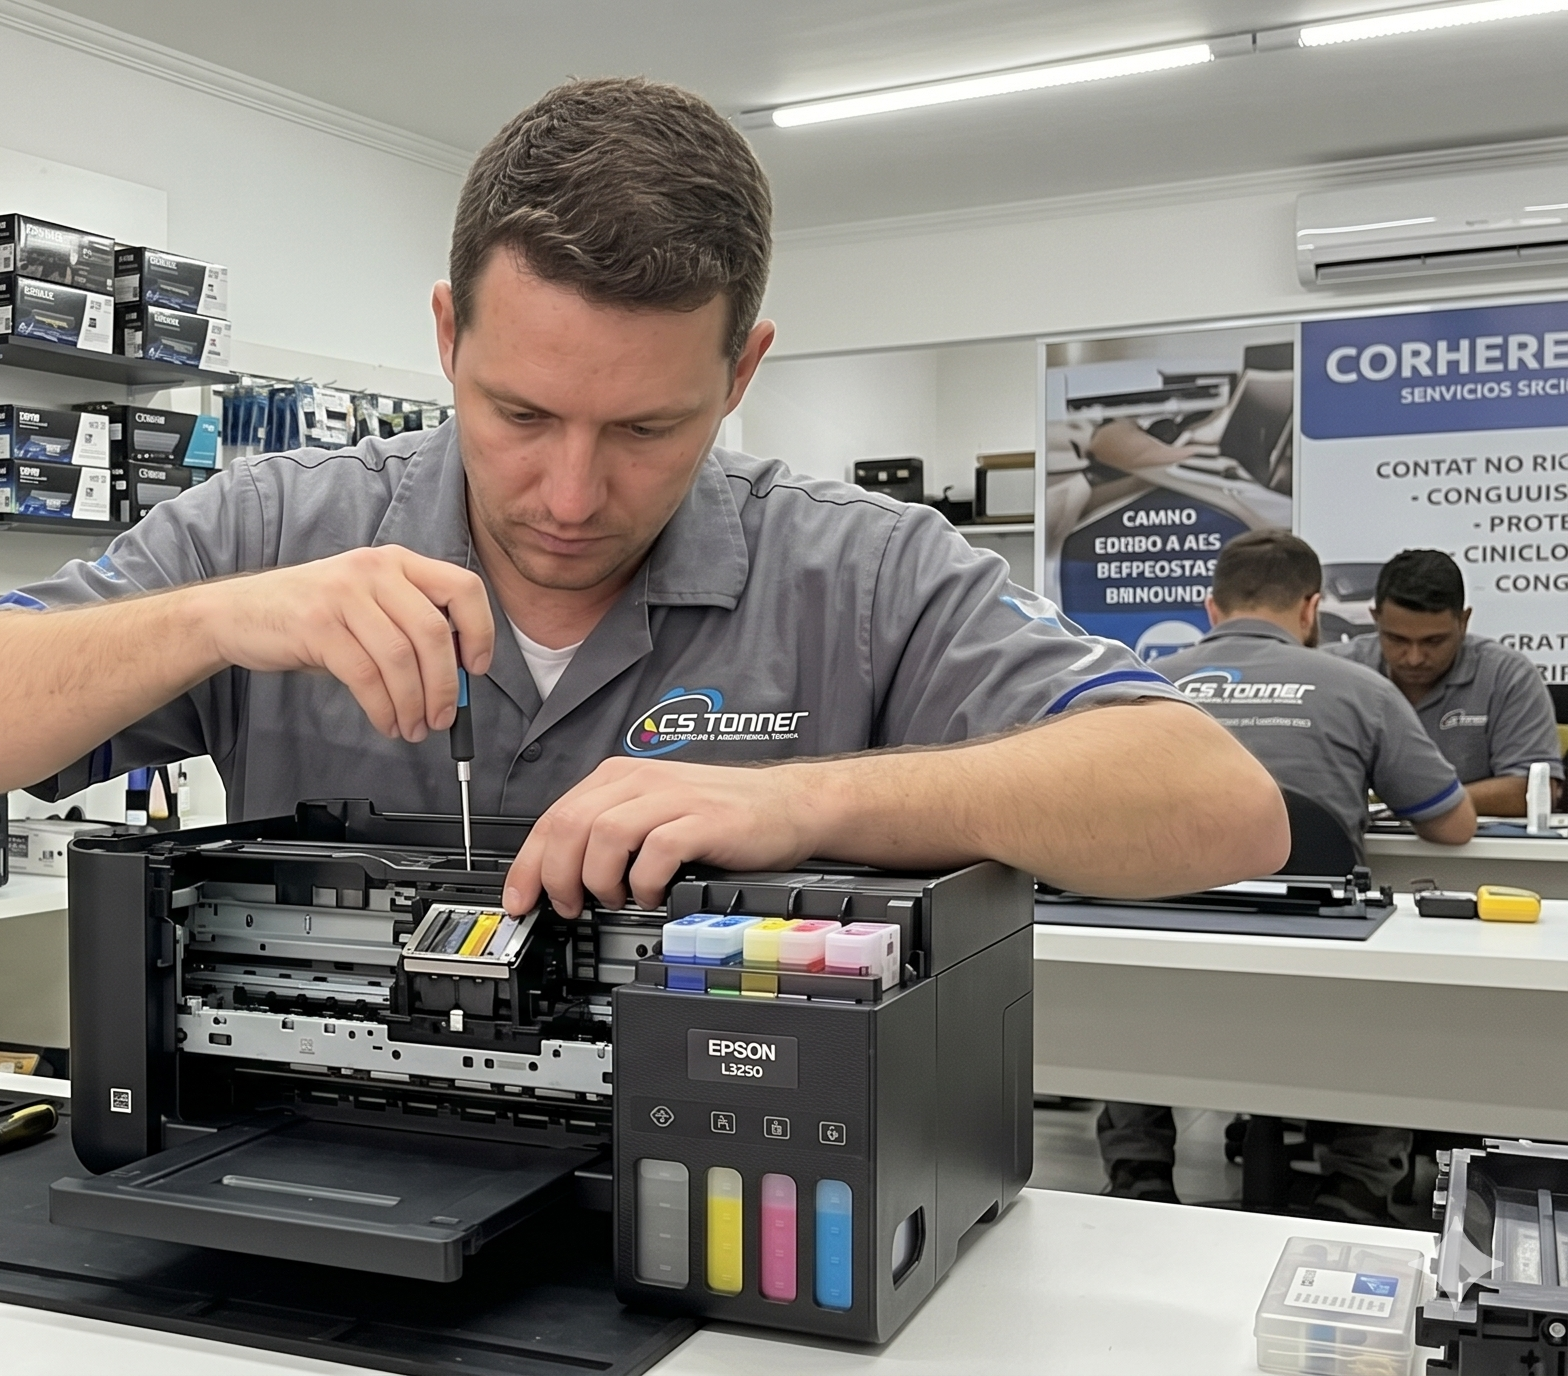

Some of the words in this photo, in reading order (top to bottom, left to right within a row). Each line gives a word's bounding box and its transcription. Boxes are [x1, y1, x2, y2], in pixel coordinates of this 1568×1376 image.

[1326, 331, 1568, 384] CORHERE
[1400, 381, 1512, 404] SENVICIOS
[1517, 377, 1568, 397] SRCI
[1376, 457, 1477, 479] CONTAT
[1485, 455, 1523, 474] NO
[1427, 483, 1568, 506] CONGUUIS
[1122, 508, 1197, 527] CAMNO
[1165, 534, 1180, 551] A
[1184, 533, 1221, 551] AES
[1464, 543, 1568, 563] CINICLO
[1495, 574, 1568, 593] CONG
[1184, 683, 1218, 698] CS
[659, 713, 698, 732] CS
[708, 1039, 776, 1061] EPSON
[721, 1062, 763, 1078] L3250
